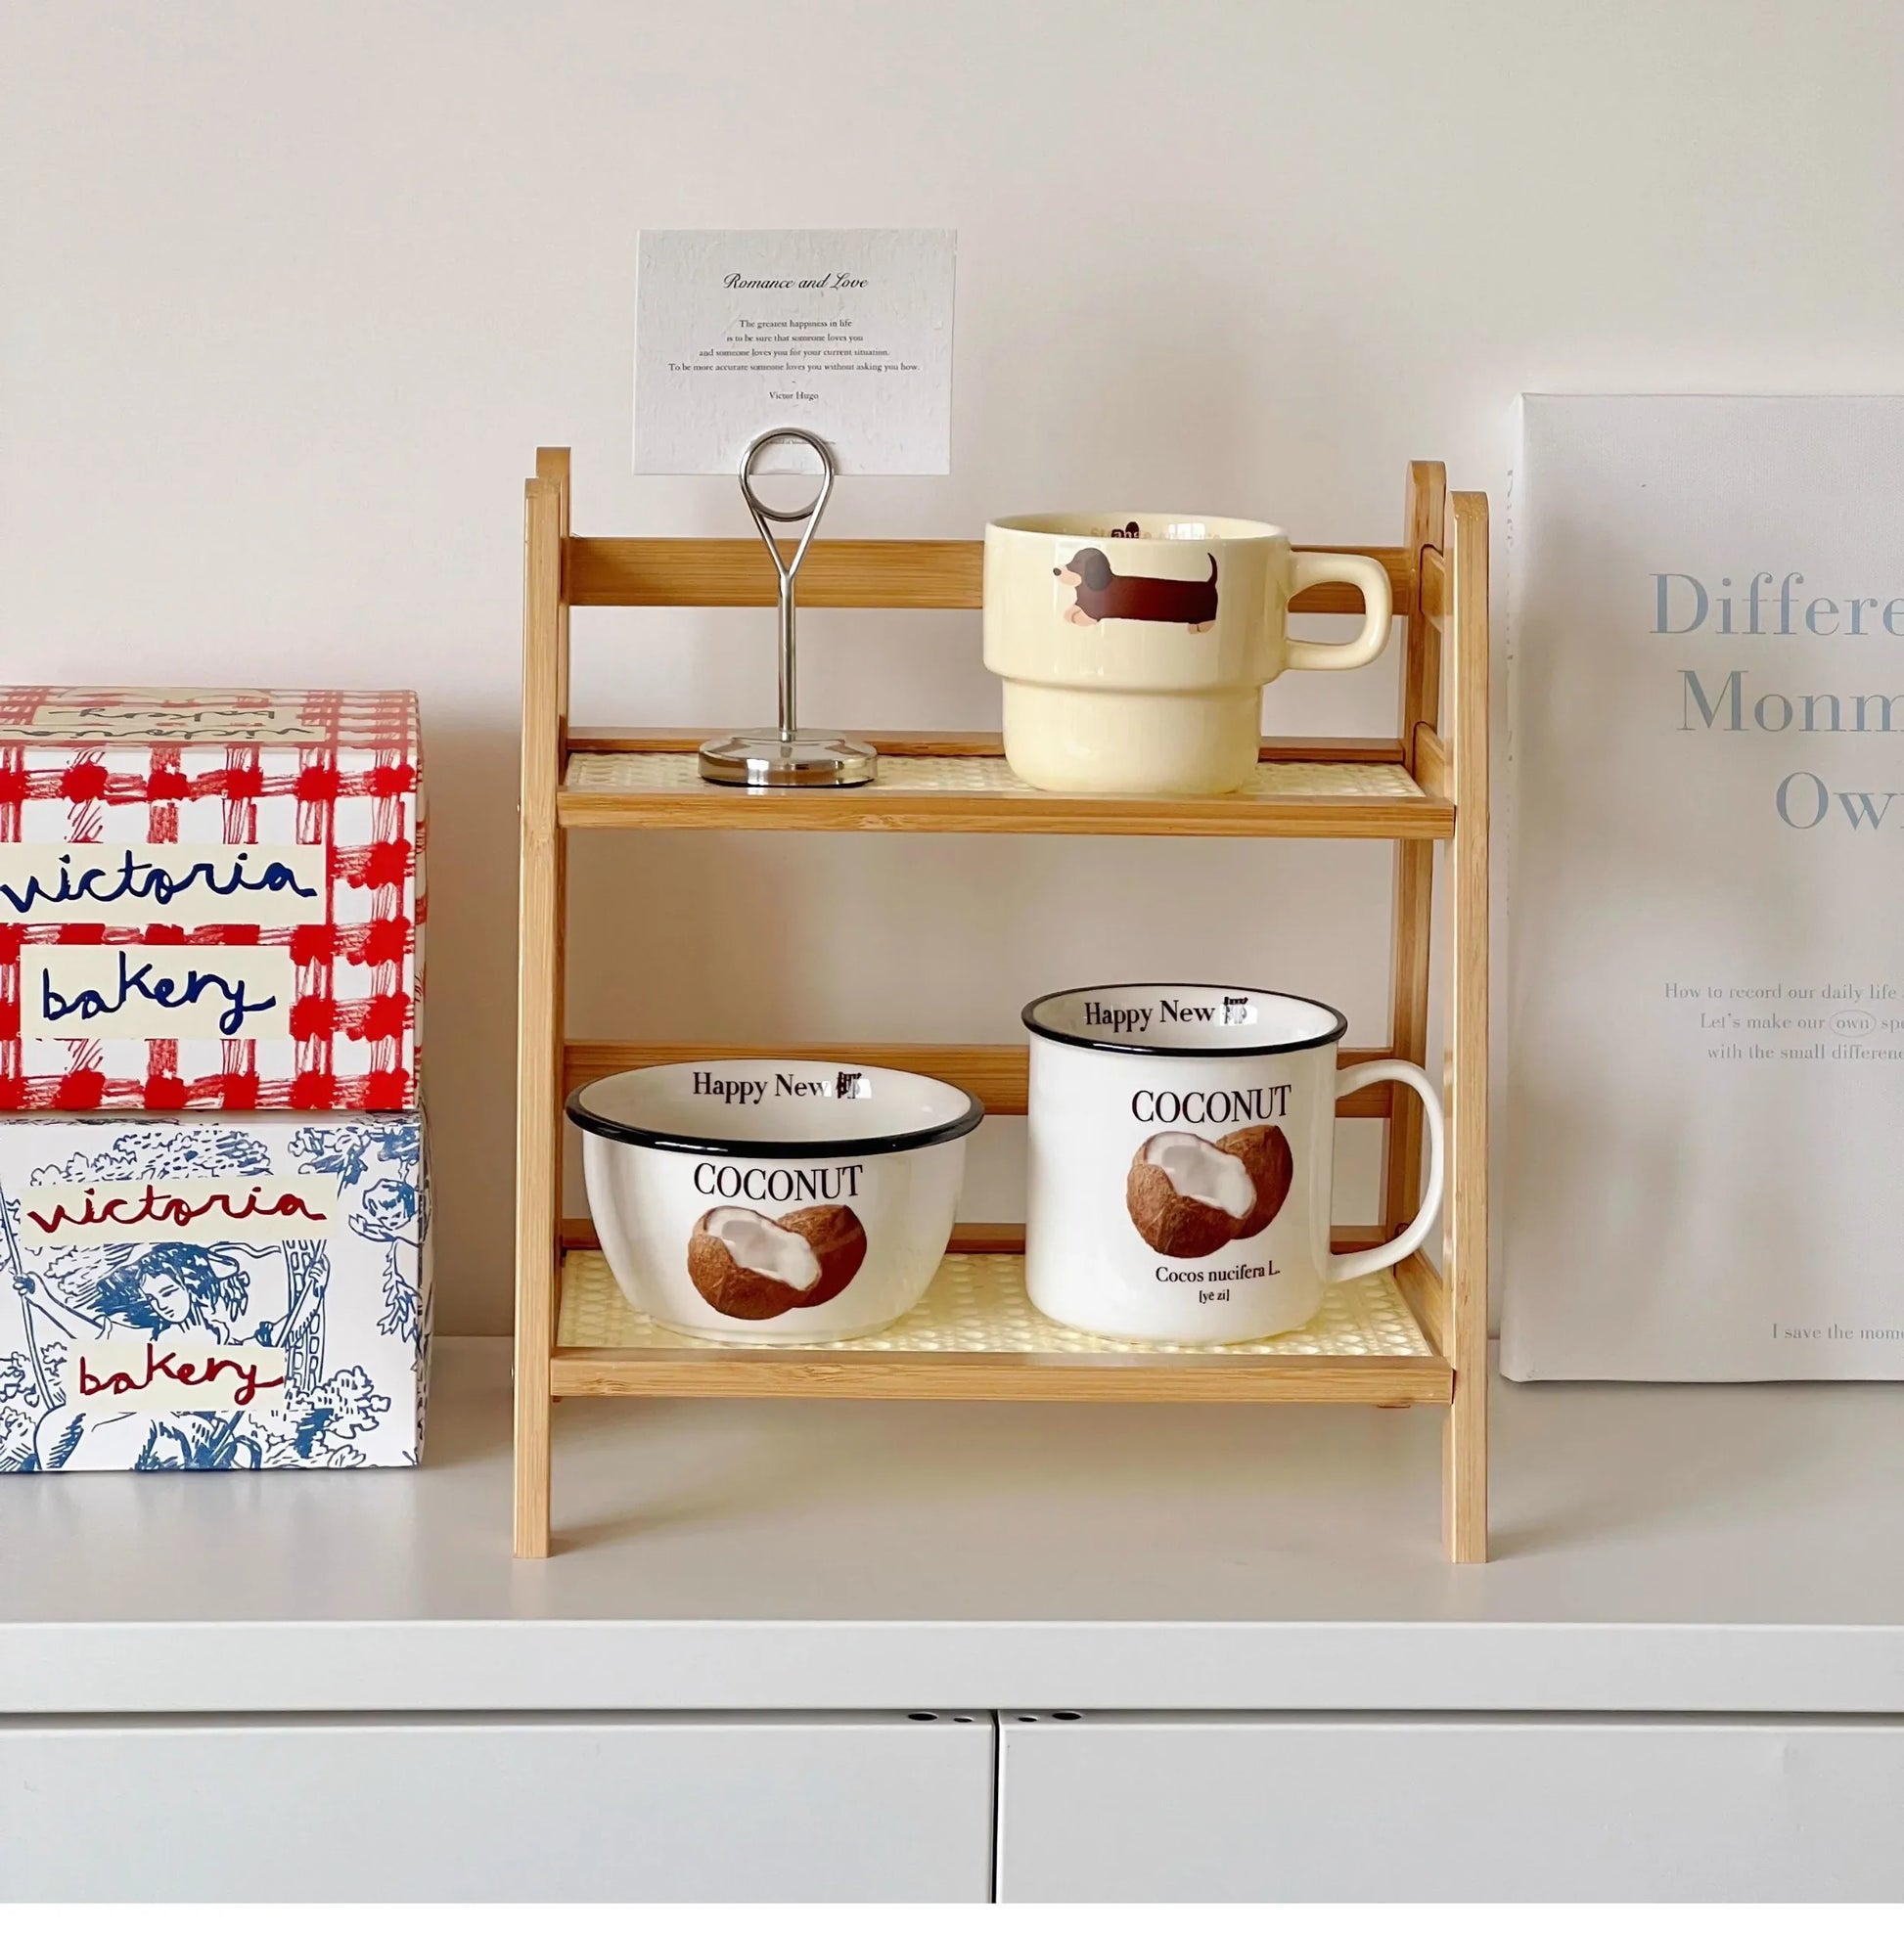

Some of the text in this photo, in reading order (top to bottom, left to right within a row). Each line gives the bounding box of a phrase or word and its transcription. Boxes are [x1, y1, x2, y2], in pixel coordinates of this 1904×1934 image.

[722, 273, 869, 291] Romance and Love
[739, 319, 853, 330] The greatest happiness in life
[735, 334, 744, 342] to
[745, 334, 753, 342] be
[774, 334, 790, 342] that
[827, 334, 847, 342] loves
[848, 335, 864, 344] you
[699, 348, 714, 357] and
[751, 348, 772, 357] loves
[773, 349, 789, 358] you
[790, 347, 801, 356] for
[802, 349, 822, 358] your
[667, 363, 681, 372] To
[856, 362, 883, 373] asking
[900, 362, 921, 371] how.
[769, 391, 819, 401] Victor Hugo
[48, 708, 275, 723] bakery
[1776, 772, 1904, 830] Ow
[0, 849, 318, 913] victoria
[42, 950, 277, 1036] bakery
[1665, 982, 1897, 1004] How to record our daily life
[1084, 1000, 1153, 1033] Happy
[1159, 999, 1216, 1023] New
[1700, 1012, 1742, 1029] Let's
[1747, 1012, 1792, 1029] make
[1797, 1018, 1826, 1029] our
[1836, 1018, 1870, 1029] own
[1707, 1044, 1743, 1059] with
[1748, 1044, 1775, 1059] the
[1780, 1044, 1826, 1059] small
[693, 1071, 768, 1104] Happy
[774, 1073, 829, 1099] New
[1131, 1084, 1292, 1123] COCONUT
[693, 1162, 864, 1201] COCONUT
[27, 1184, 328, 1234] victoria
[1156, 1260, 1281, 1282] Cocos nucifera L.
[1772, 1323, 1778, 1339] I
[1784, 1328, 1822, 1339] save
[1827, 1323, 1854, 1339] the
[79, 1341, 286, 1406] bakery
